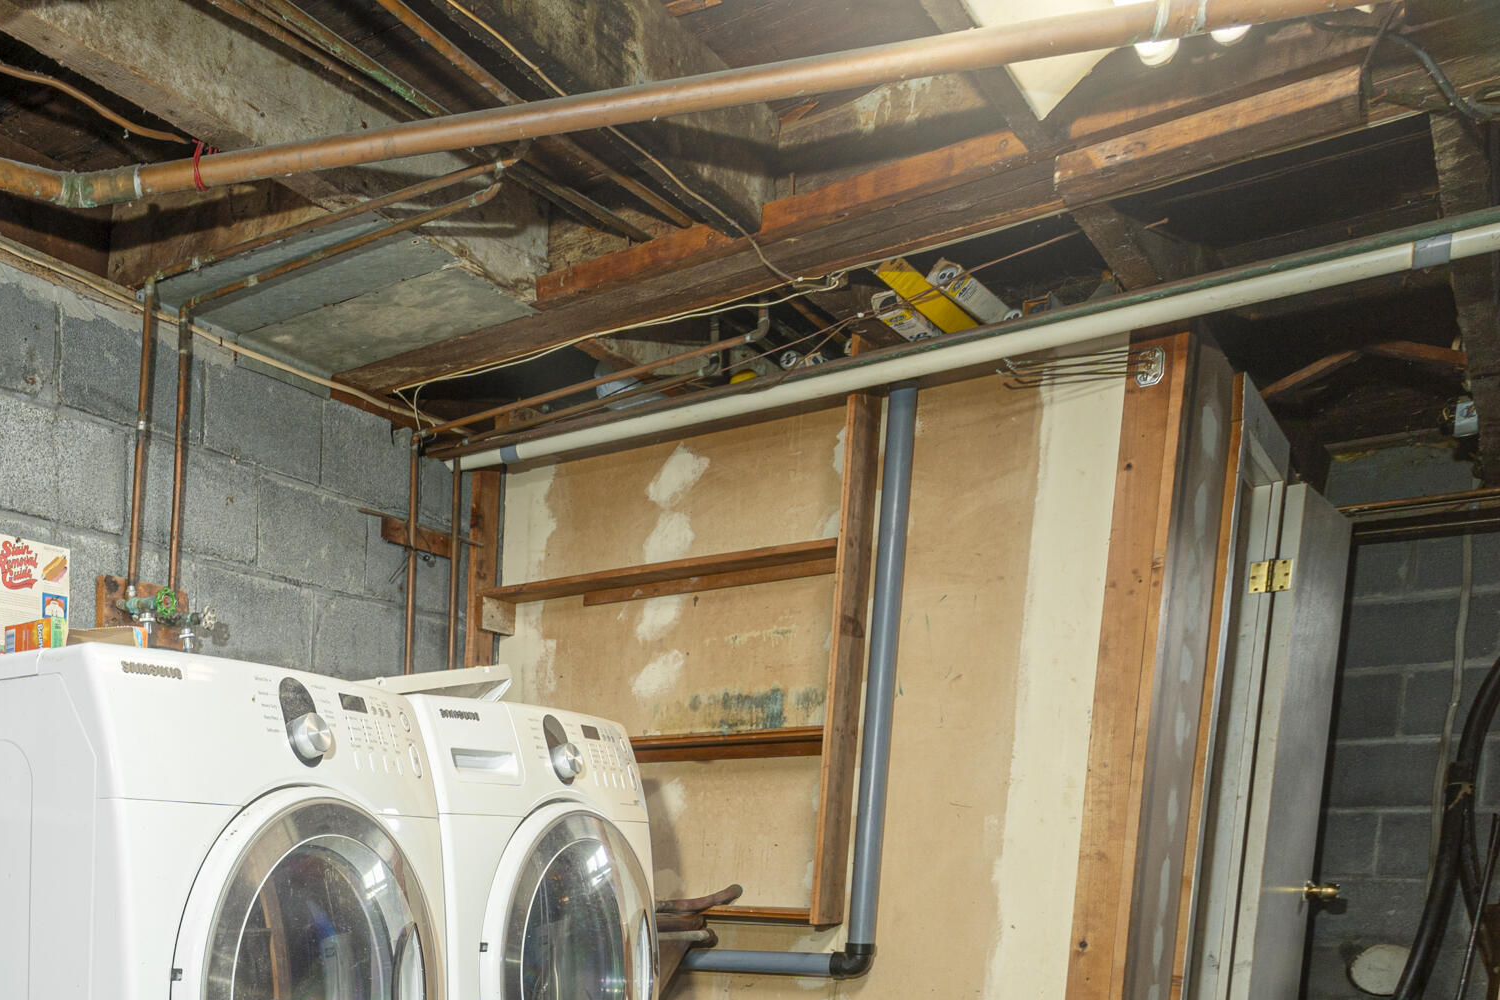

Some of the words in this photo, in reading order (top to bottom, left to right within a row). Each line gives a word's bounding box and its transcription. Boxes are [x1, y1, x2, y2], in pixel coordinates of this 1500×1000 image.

[1, 540, 33, 556] Stain
[121, 660, 182, 680] SAMSUNG
[439, 708, 480, 721] SAMSUNG
